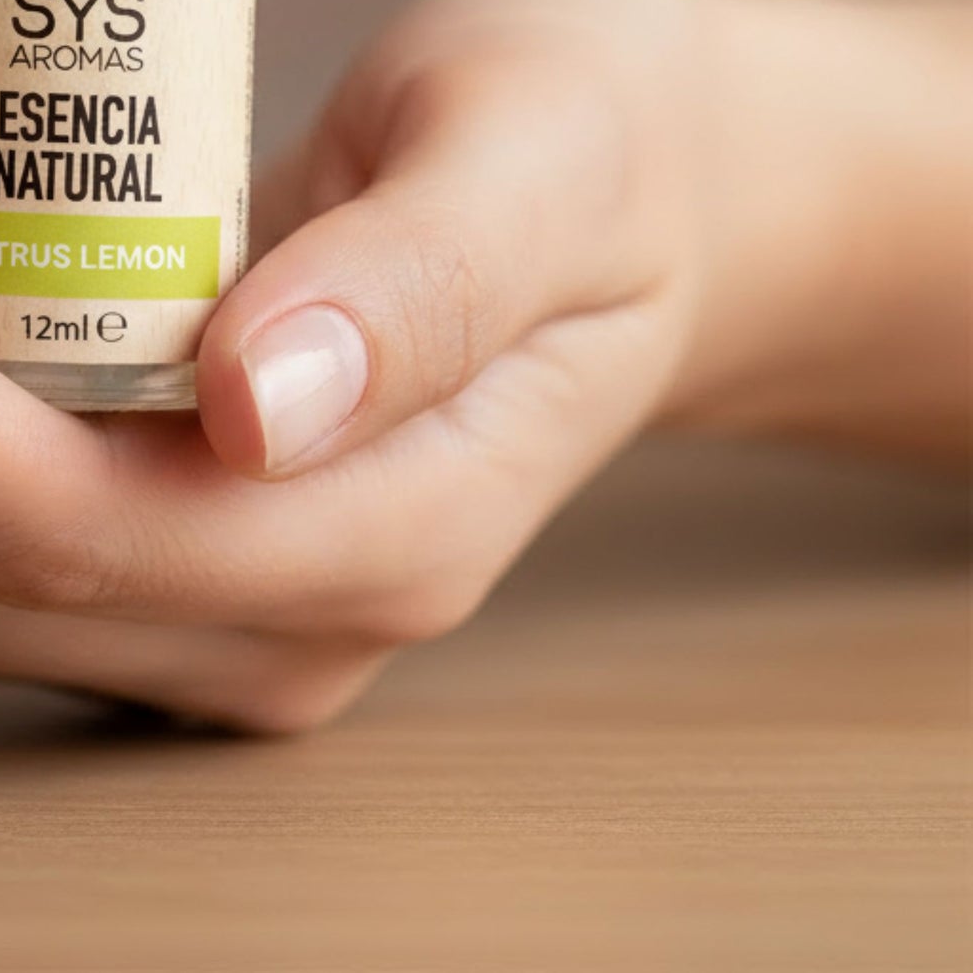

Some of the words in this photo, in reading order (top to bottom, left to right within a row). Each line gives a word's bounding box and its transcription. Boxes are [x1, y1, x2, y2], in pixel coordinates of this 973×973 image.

[8, 43, 145, 72] AROMAS
[79, 244, 187, 272] LEMON
[20, 313, 89, 342] 12ml
